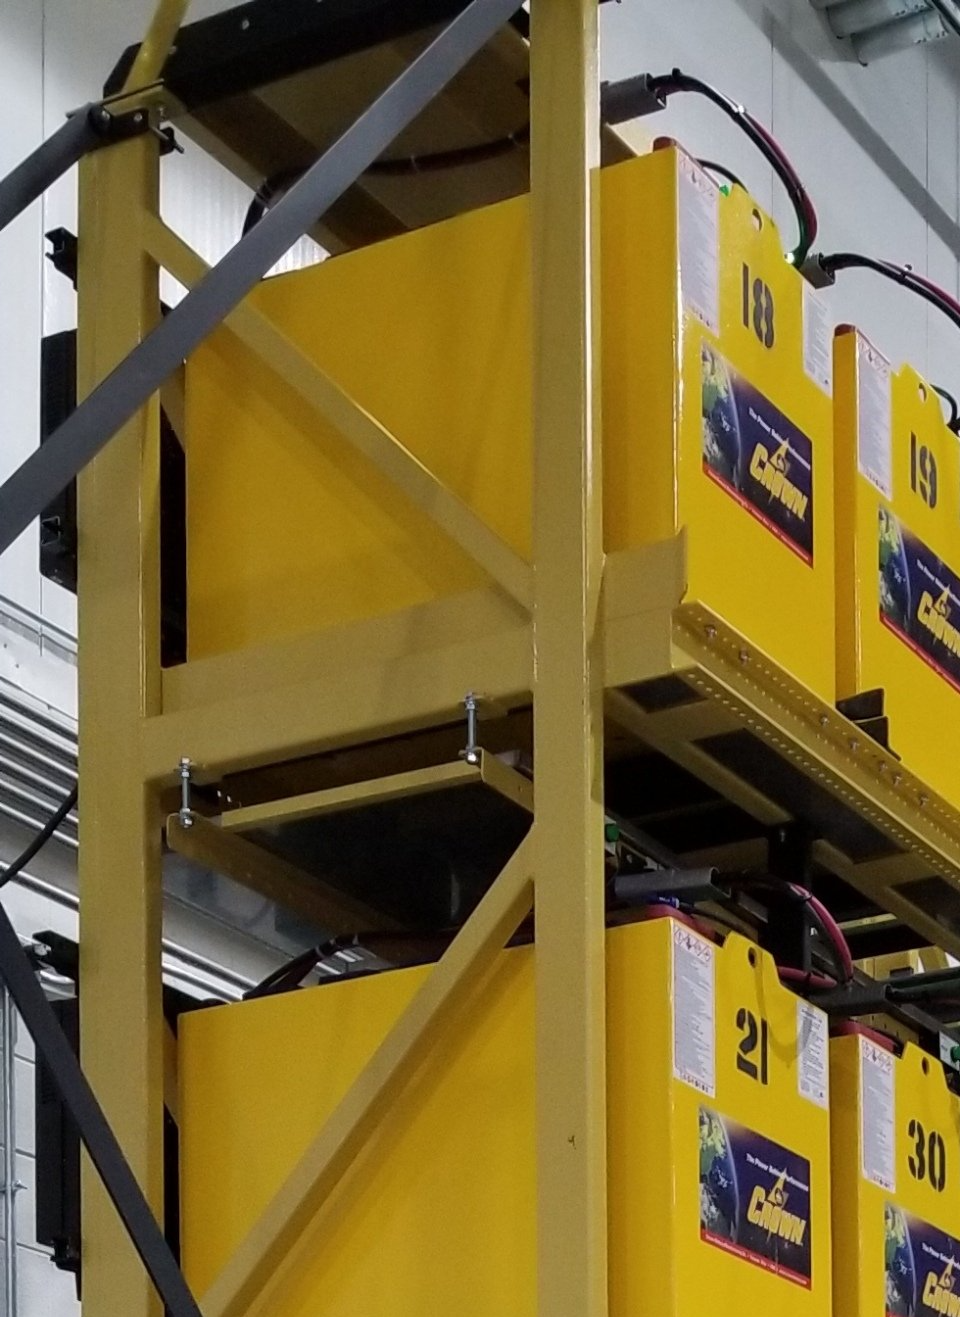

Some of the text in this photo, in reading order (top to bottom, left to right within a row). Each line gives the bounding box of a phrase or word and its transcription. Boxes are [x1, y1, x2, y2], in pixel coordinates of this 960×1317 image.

[742, 262, 775, 350] 18
[749, 442, 808, 521] CROWN
[910, 431, 938, 509] 19
[736, 1007, 768, 1085] 21
[907, 1119, 946, 1193] 30
[747, 1184, 807, 1246] CROWN
